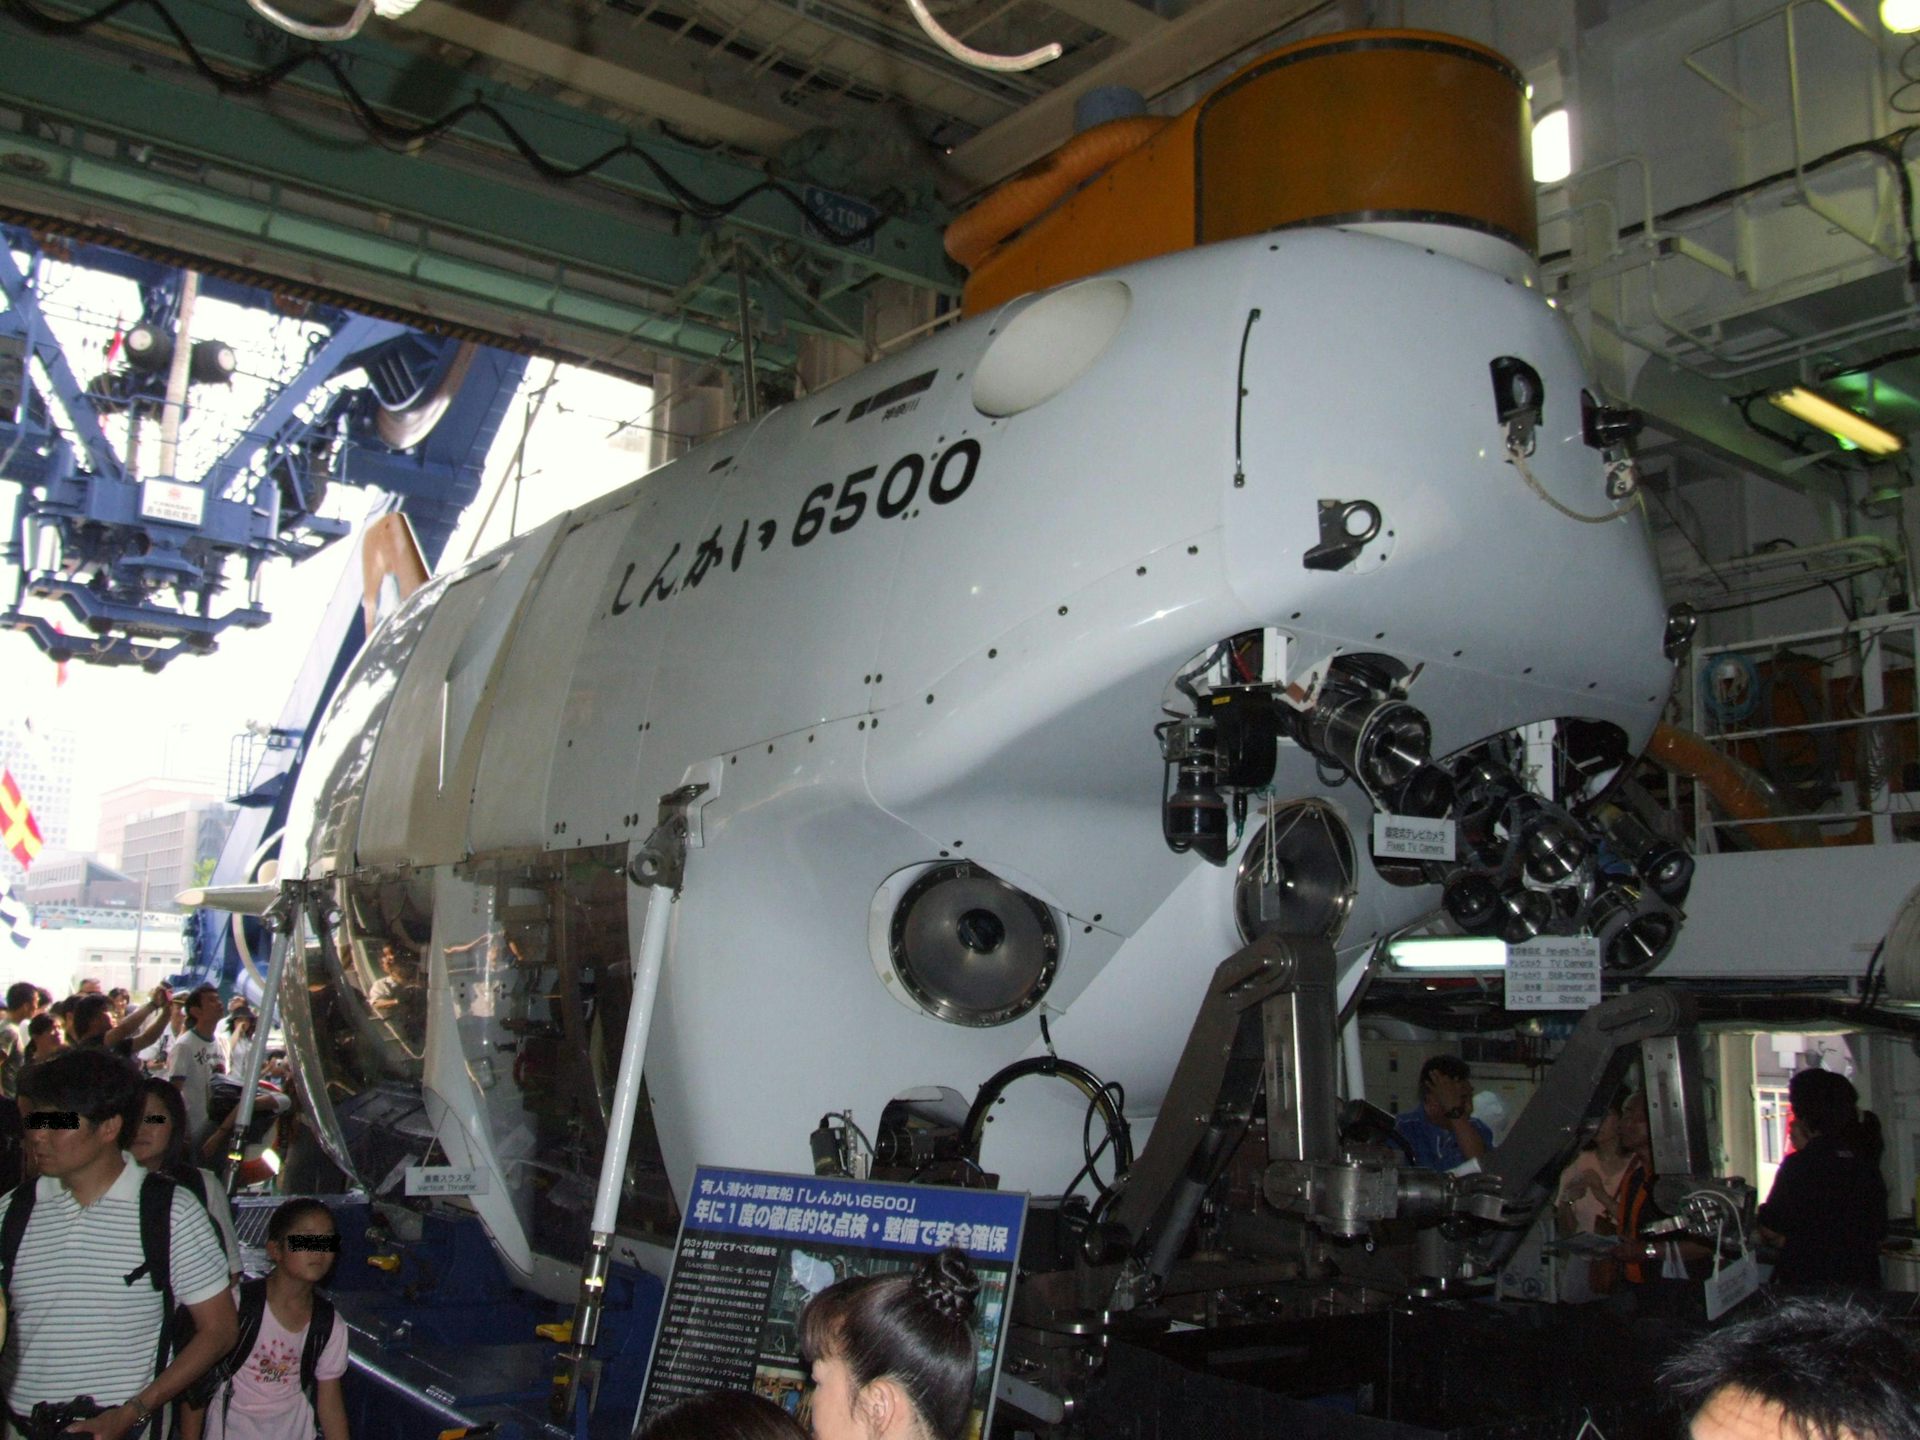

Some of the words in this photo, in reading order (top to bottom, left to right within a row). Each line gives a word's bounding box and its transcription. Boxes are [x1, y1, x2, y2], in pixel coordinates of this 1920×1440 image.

[1550, 959, 1561, 967] TV
[1563, 959, 1593, 968] Camera
[700, 1179, 917, 1214] 有人潜水調査船「しんかい6500」
